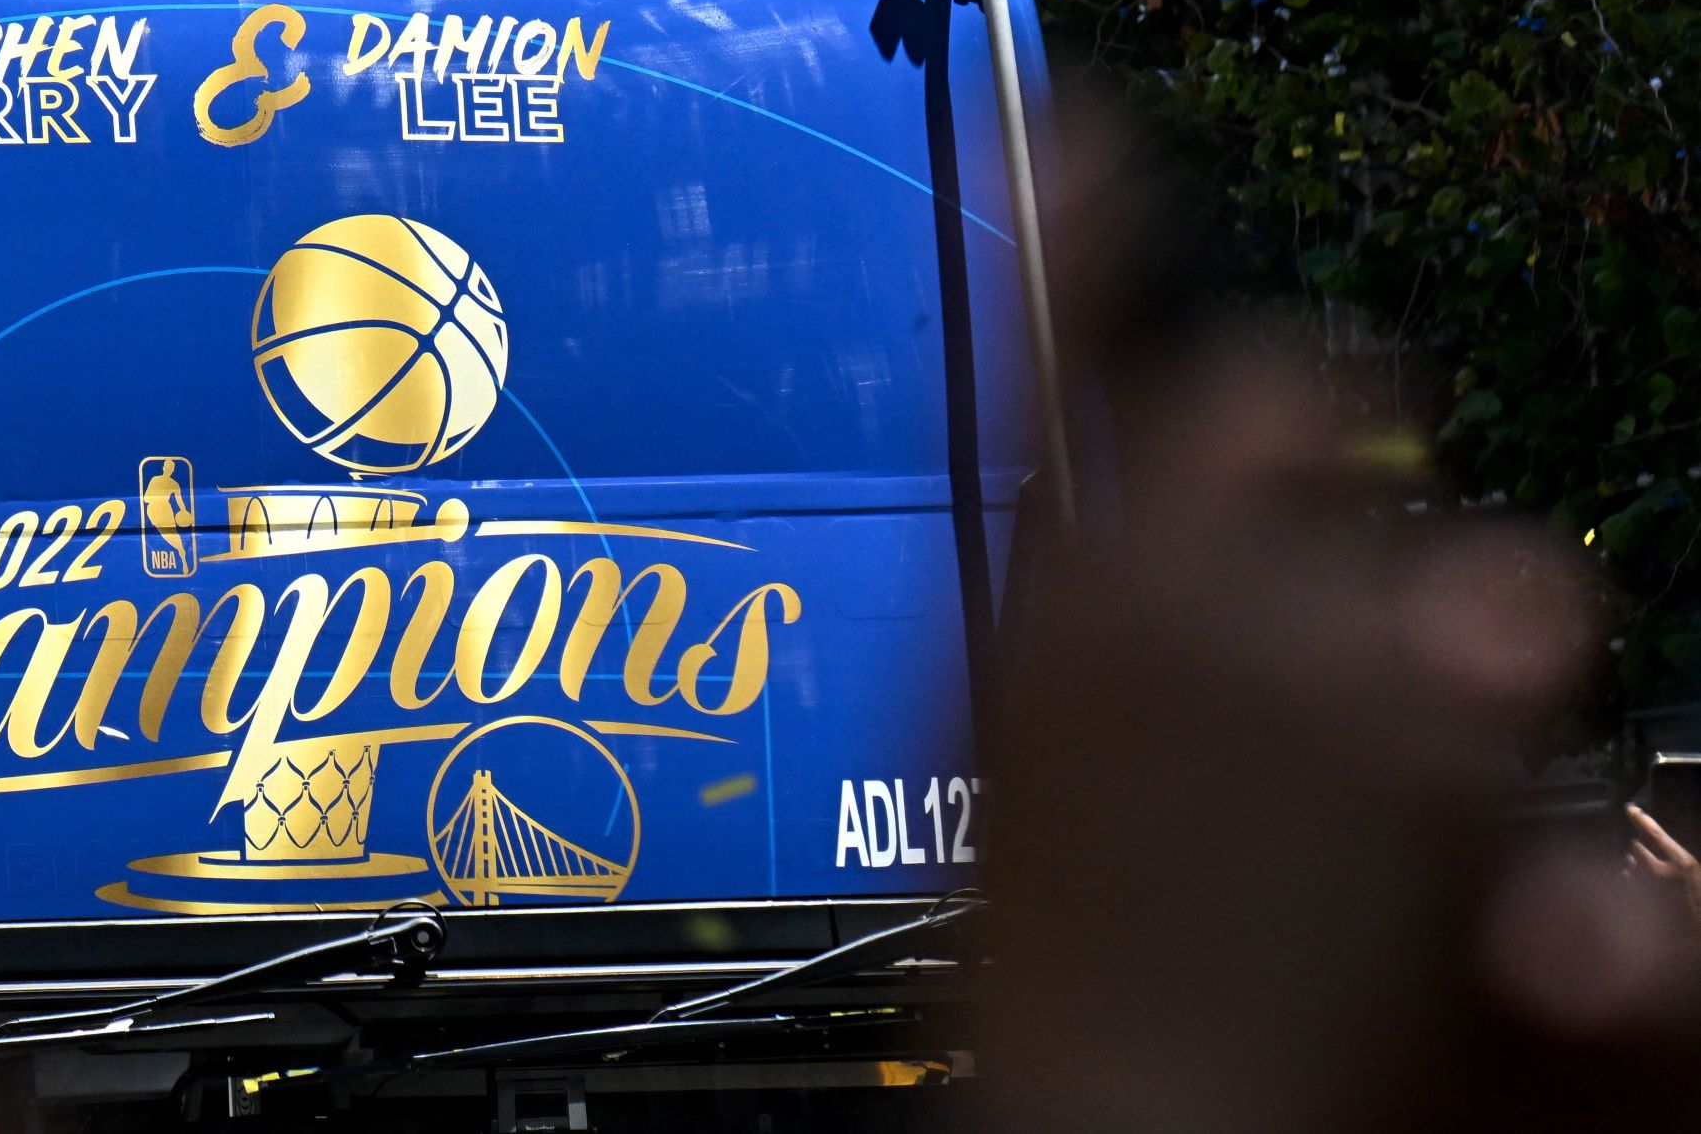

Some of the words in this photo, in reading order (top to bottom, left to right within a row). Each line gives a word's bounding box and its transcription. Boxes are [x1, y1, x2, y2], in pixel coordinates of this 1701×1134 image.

[193, 4, 311, 147] &
[341, 12, 611, 84] DAMION
[395, 72, 565, 142] LEE
[151, 550, 177, 569] NBA
